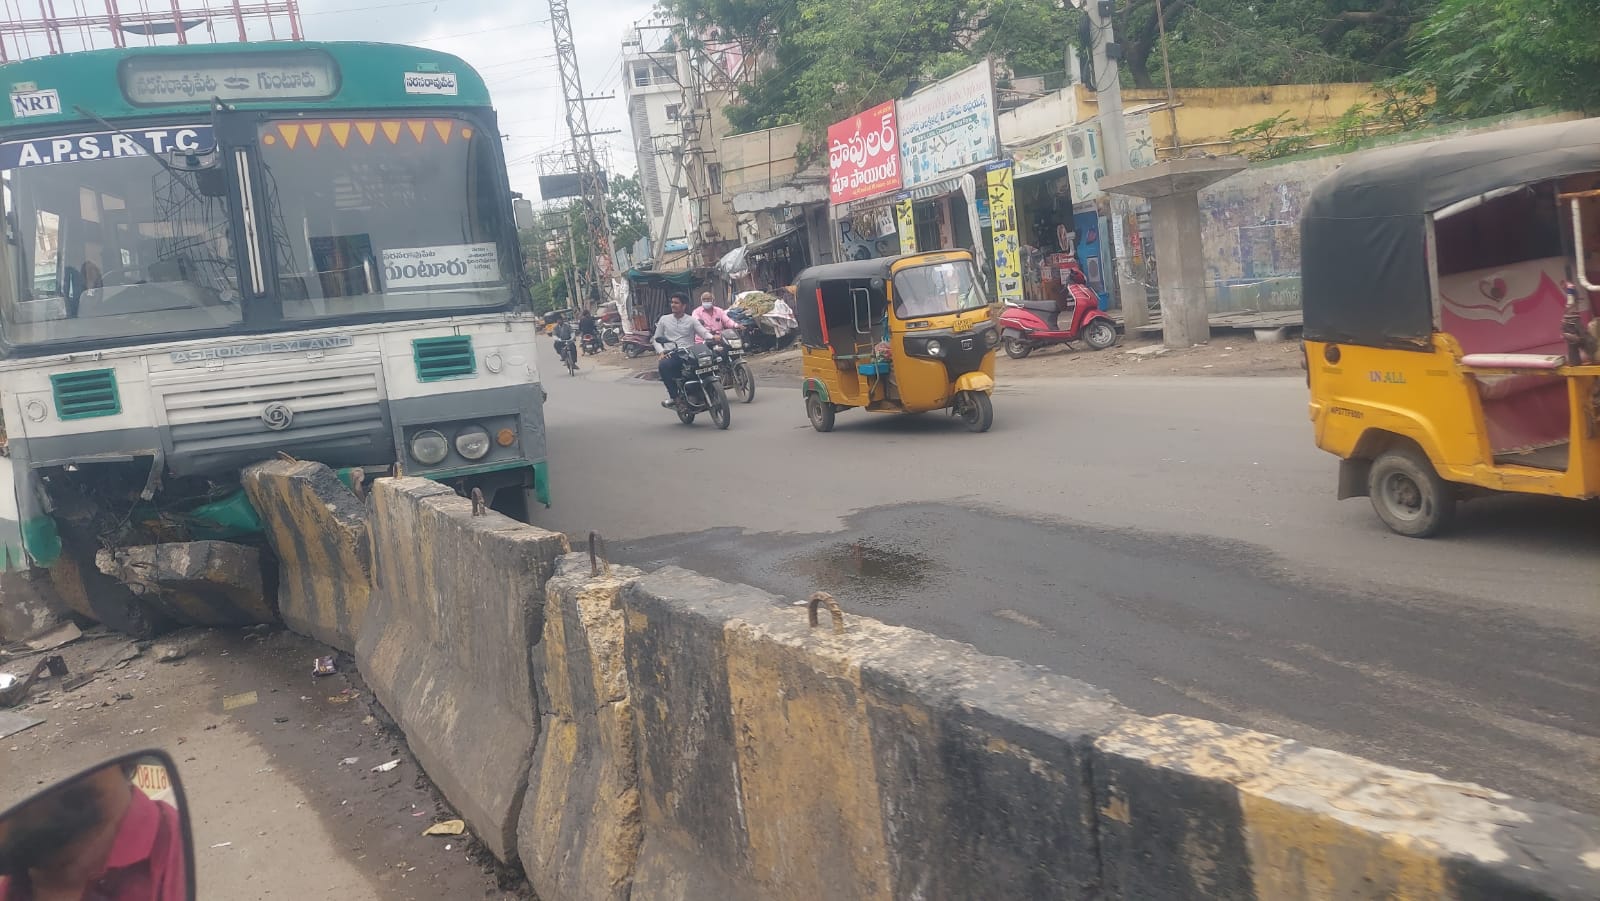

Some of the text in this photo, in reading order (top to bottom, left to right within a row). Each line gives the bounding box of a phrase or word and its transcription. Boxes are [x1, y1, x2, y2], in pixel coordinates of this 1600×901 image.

[257, 71, 316, 90] గుంటూరు
[16, 95, 55, 112] NRT
[829, 113, 895, 169] పాపులర్
[850, 153, 897, 188] పాయింట్
[384, 257, 468, 281] గుంటూరు
[174, 344, 246, 363] ASHOK
